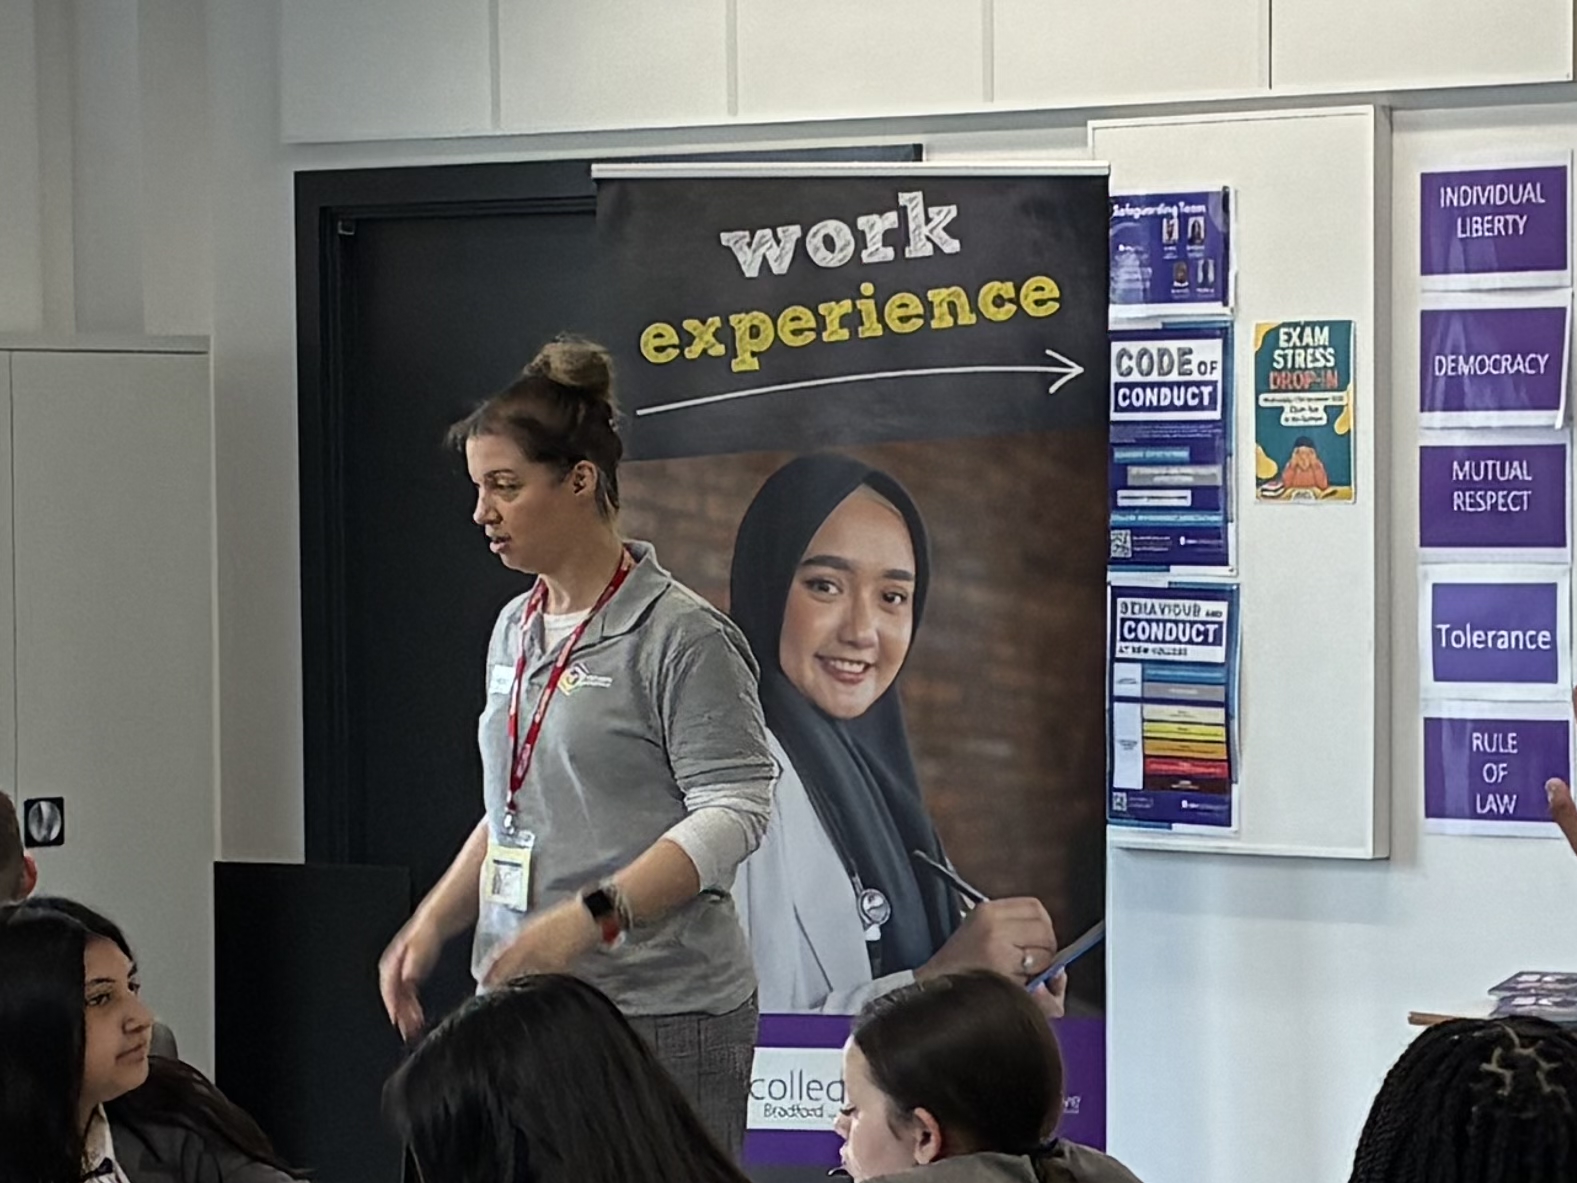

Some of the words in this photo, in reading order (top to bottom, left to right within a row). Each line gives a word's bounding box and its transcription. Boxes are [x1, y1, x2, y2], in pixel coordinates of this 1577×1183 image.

[1440, 182, 1546, 208] INDIVIDUAL
[720, 191, 961, 278] work
[1457, 215, 1528, 238] LIBERTY
[640, 275, 1060, 372] experience
[1279, 326, 1329, 348] EXAM
[1115, 347, 1193, 377] CODE
[1197, 360, 1218, 375] OF
[1273, 348, 1336, 369] STRESS
[1434, 353, 1550, 376] DEMOCRACY
[1117, 386, 1213, 407] CONDUCT
[1452, 460, 1532, 482] MUTUAL
[1453, 490, 1532, 512] RESPECT
[1123, 621, 1219, 643] CONDUCT
[1436, 623, 1552, 650] Tolerance
[1472, 732, 1518, 754] RULE
[1483, 763, 1508, 783] OF
[1475, 794, 1517, 815] LAW
